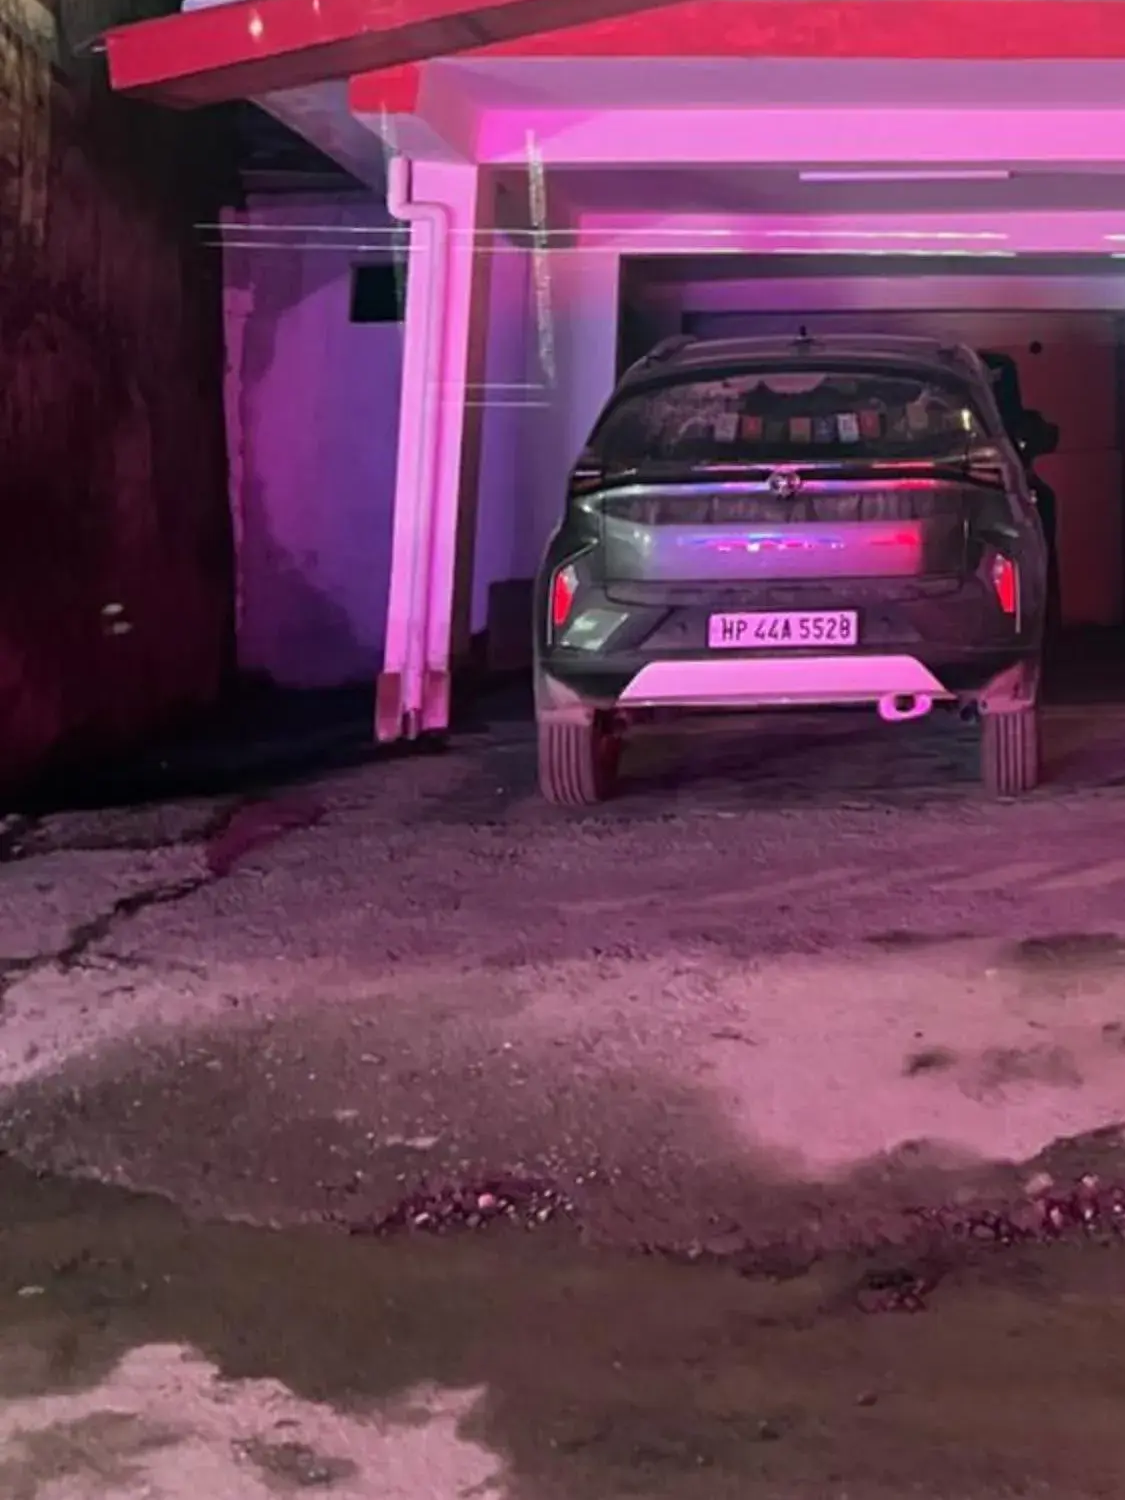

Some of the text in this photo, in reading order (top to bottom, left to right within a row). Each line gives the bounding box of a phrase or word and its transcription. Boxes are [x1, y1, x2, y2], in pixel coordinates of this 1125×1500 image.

[721, 616, 851, 641] HP 44A 5528
